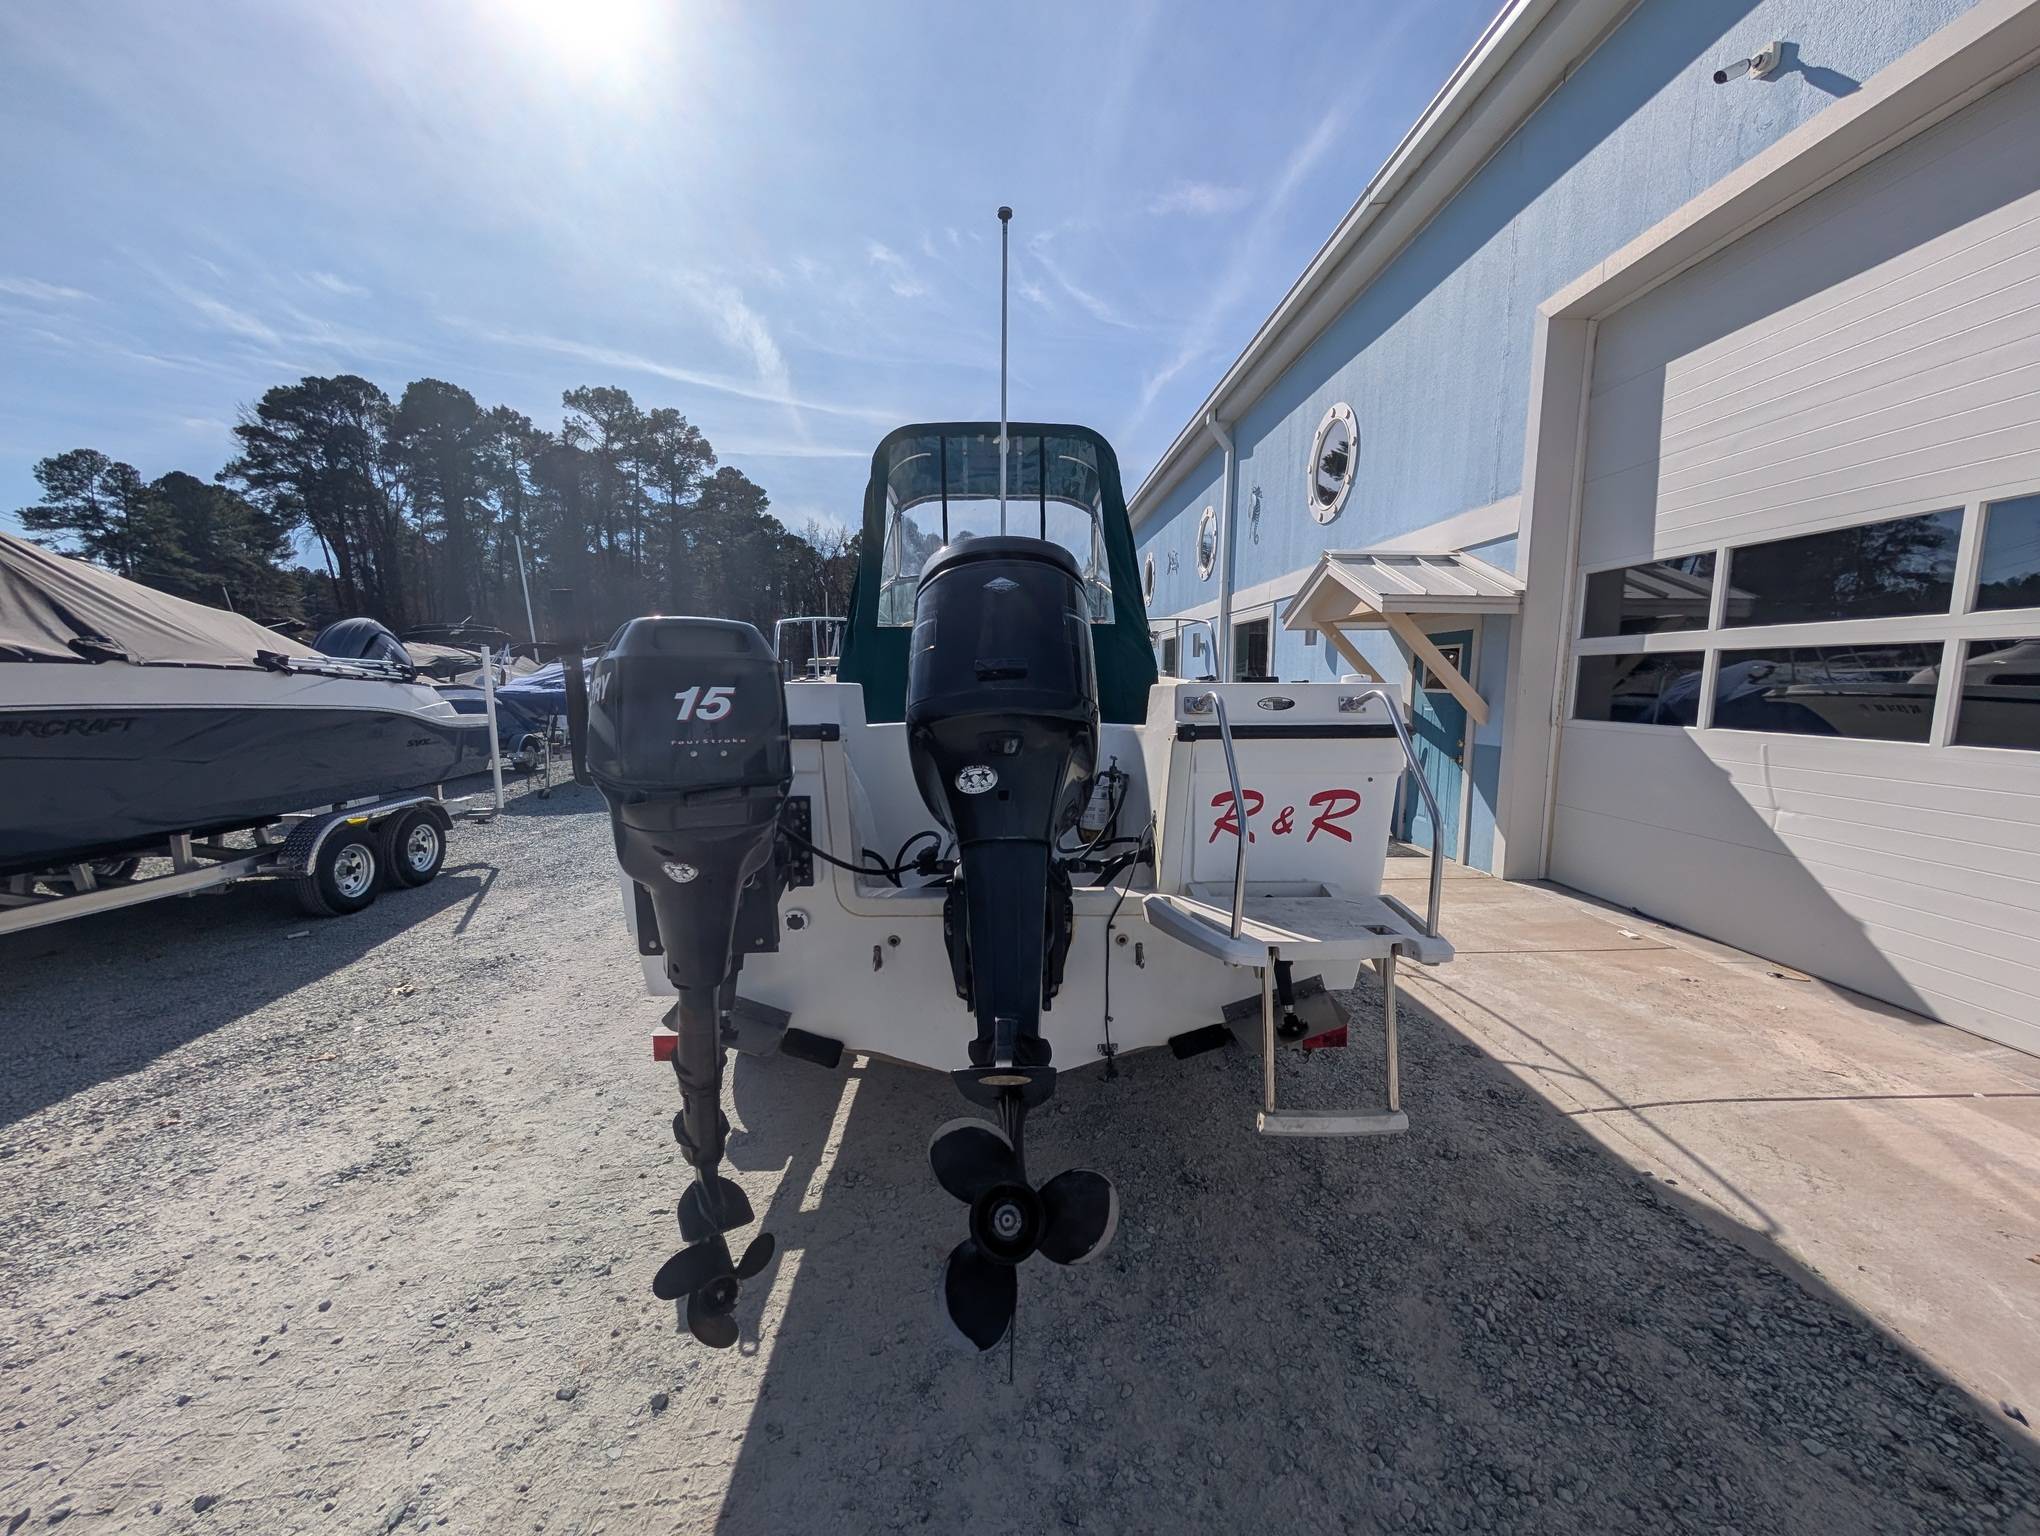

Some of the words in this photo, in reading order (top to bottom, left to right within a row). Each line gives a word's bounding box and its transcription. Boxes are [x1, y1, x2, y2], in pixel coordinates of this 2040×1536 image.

[674, 686, 736, 722] 15
[1209, 789, 1264, 843] R
[1271, 806, 1295, 835] &
[1306, 789, 1361, 843] R
